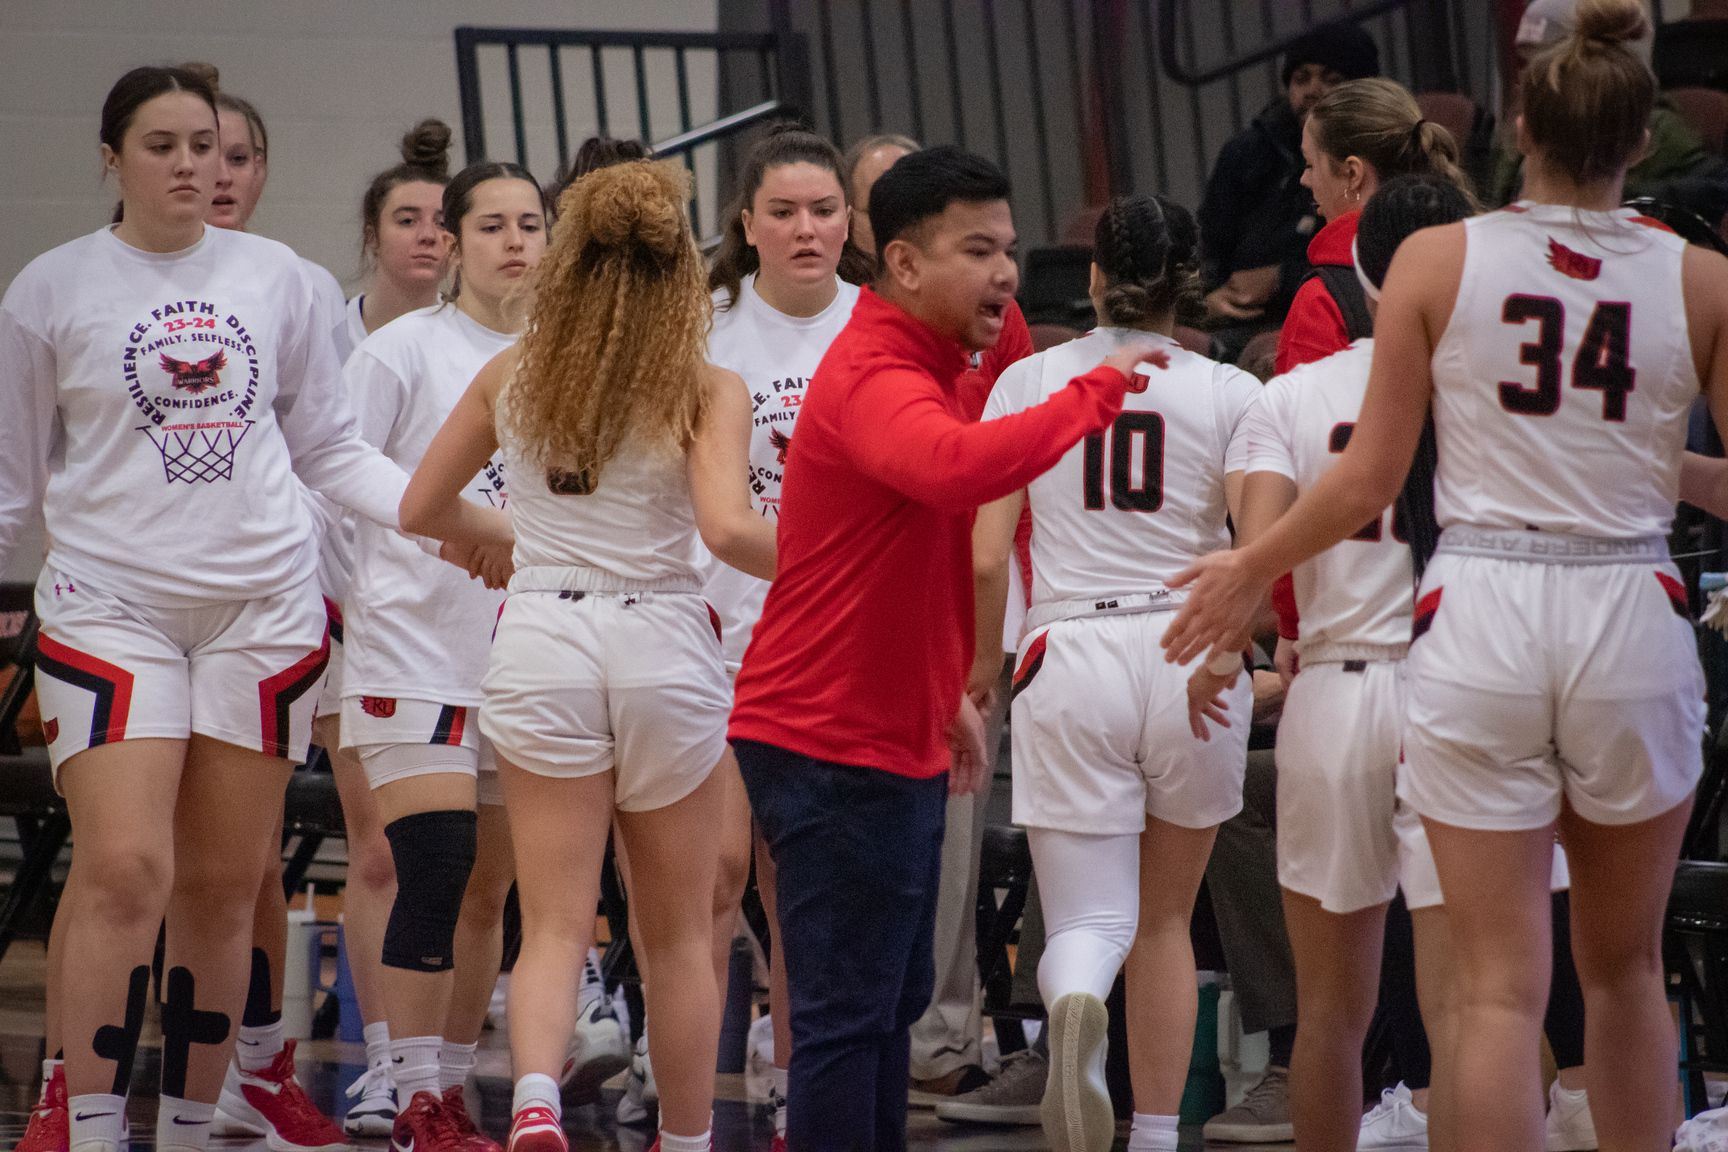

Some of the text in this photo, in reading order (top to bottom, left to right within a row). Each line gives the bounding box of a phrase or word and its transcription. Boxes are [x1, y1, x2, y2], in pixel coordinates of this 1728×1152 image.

[151, 300, 219, 321] FAITH.
[163, 317, 216, 333] 23-24
[140, 332, 244, 356] FAMILY. SELFLESS.
[1497, 292, 1636, 423] 34
[154, 390, 238, 409] CONFIDENCE.
[161, 421, 244, 432] WOMEN'S BASKETBALL
[1083, 410, 1165, 514] 10
